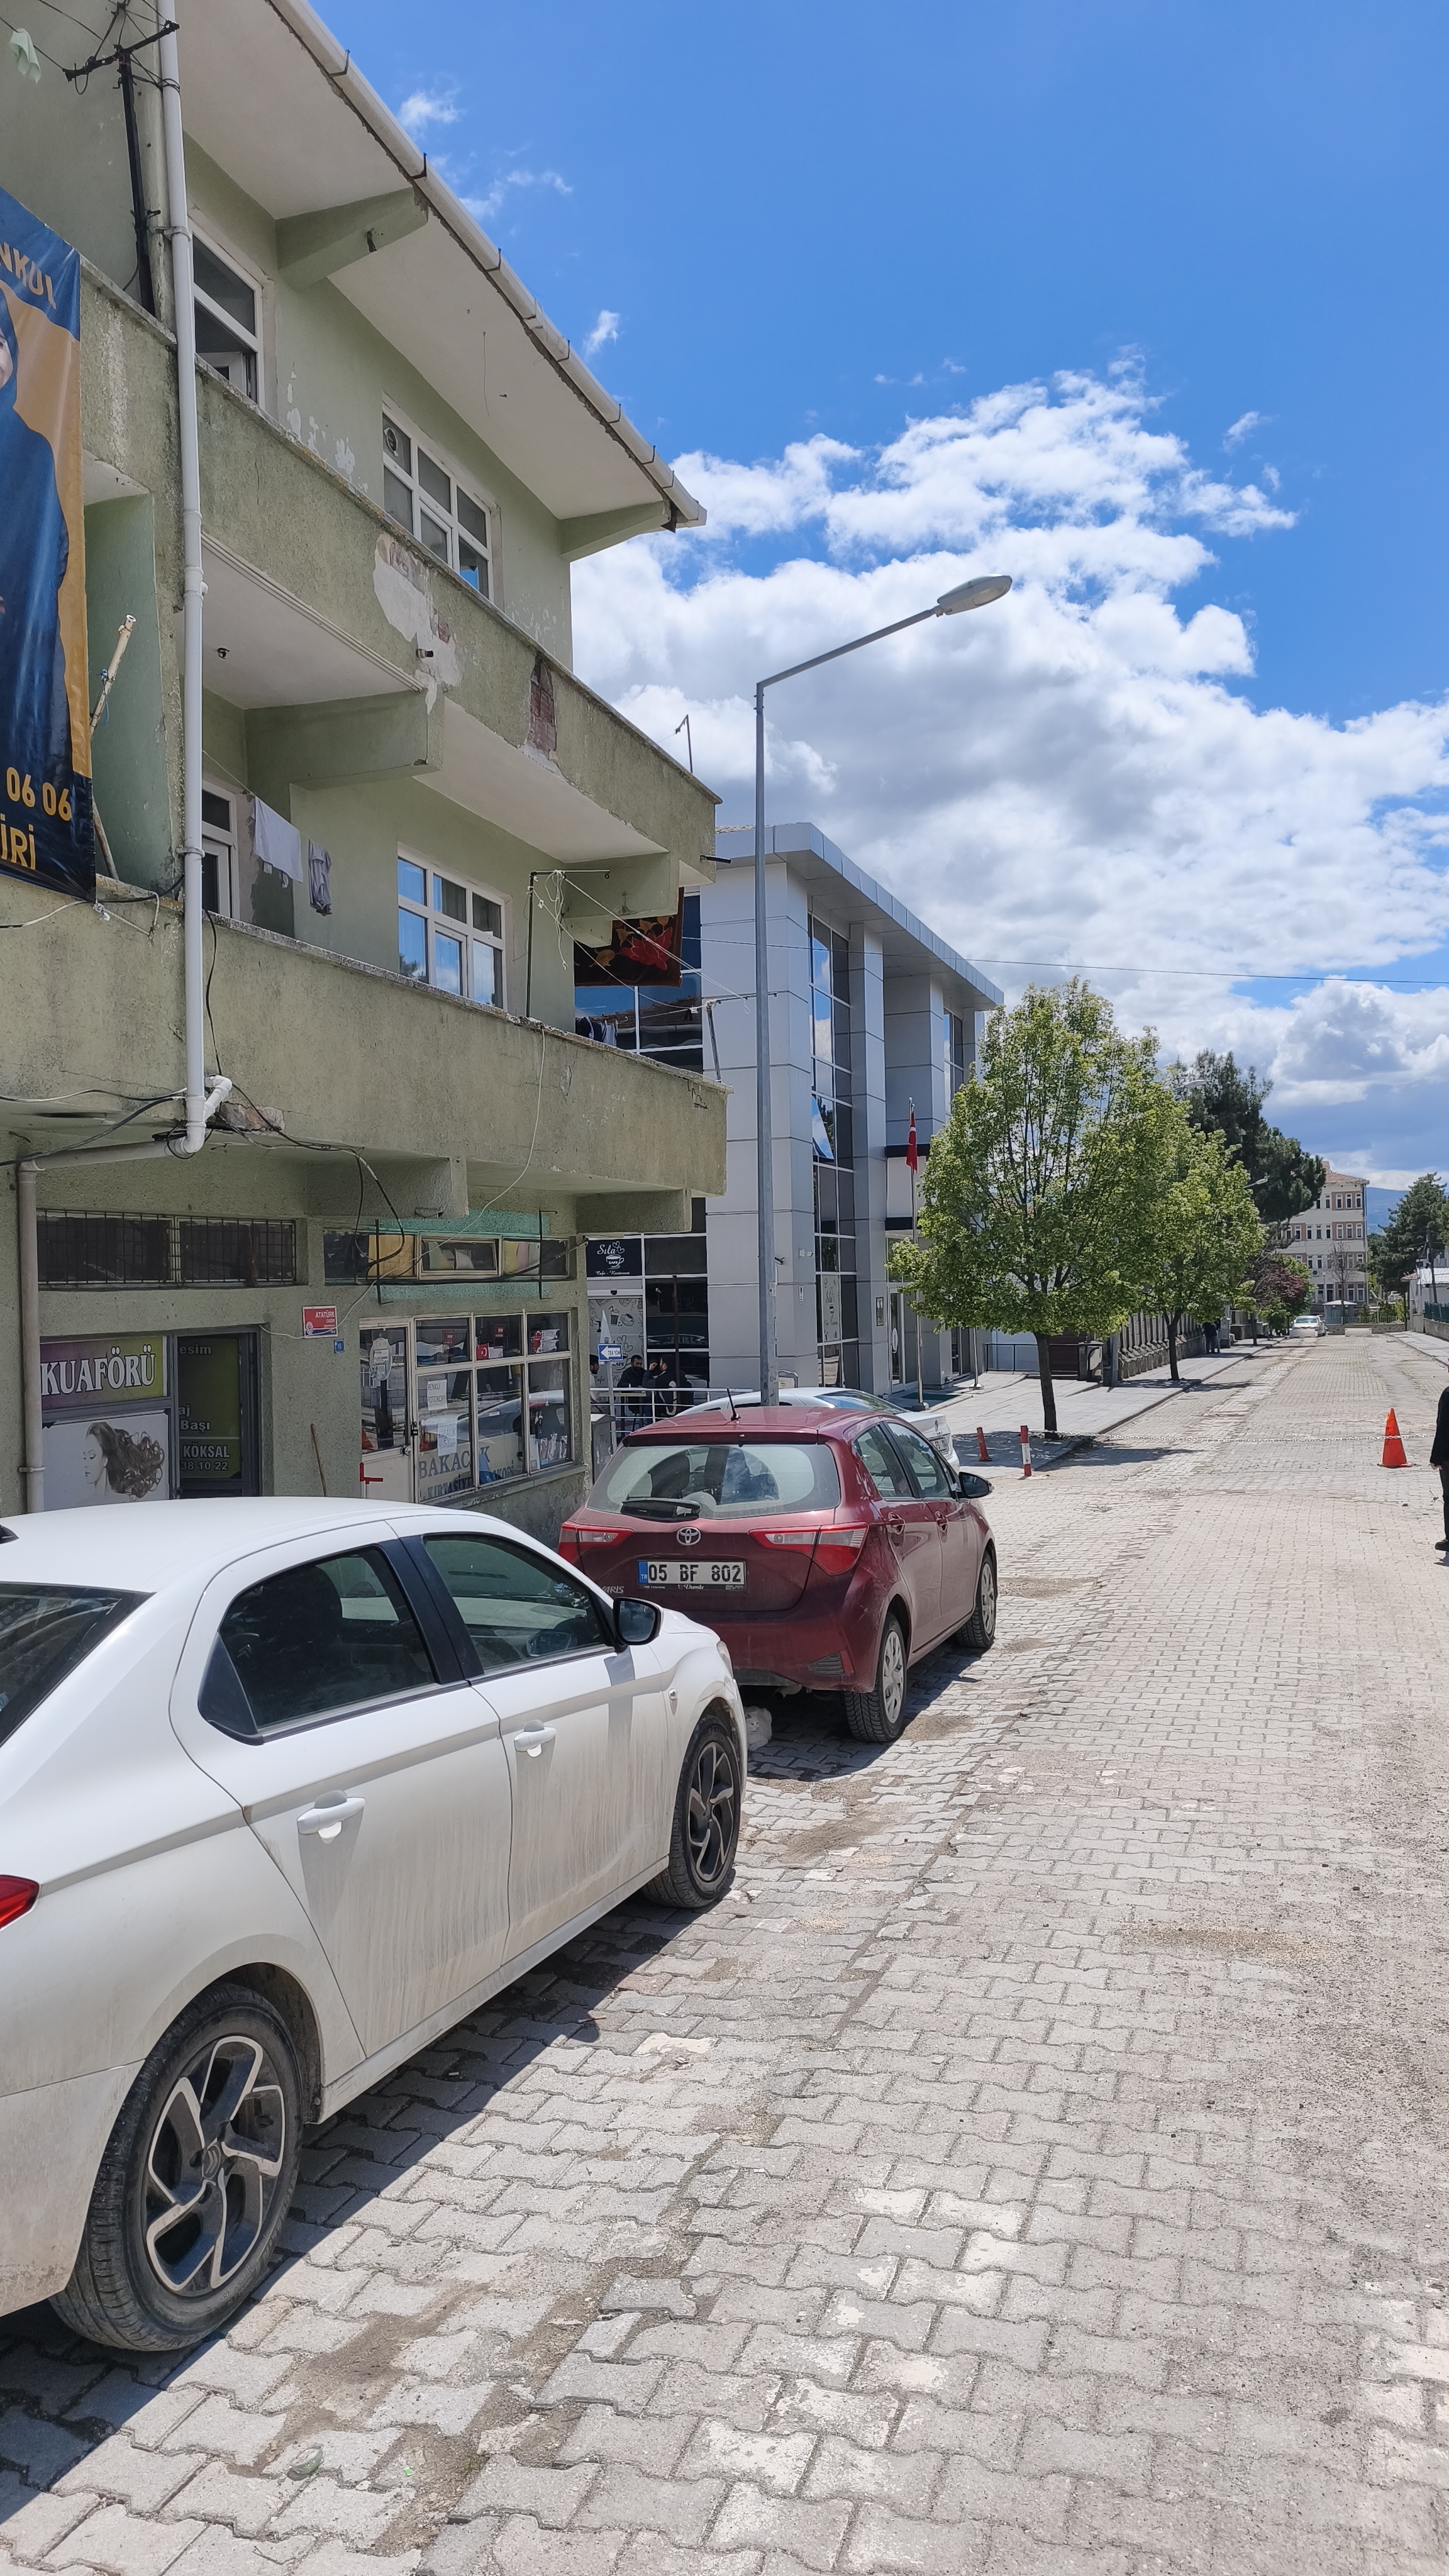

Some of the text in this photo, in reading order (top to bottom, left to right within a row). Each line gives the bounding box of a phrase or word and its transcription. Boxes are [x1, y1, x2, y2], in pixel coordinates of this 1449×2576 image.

[6, 767, 72, 821] 06 06
[0, 813, 36, 870] İRİ
[315, 1310, 335, 1319] ATATÜRK
[179, 1343, 212, 1355] esim
[40, 1345, 155, 1396] KUAFÖRÜ
[178, 1404, 191, 1417] aj
[180, 1419, 210, 1433] Başı
[183, 1442, 230, 1458] KÖKSAL
[180, 1461, 228, 1470] 38 10 22
[419, 1446, 491, 1479] BAKACK
[648, 1564, 741, 1582] 05 BF 802
